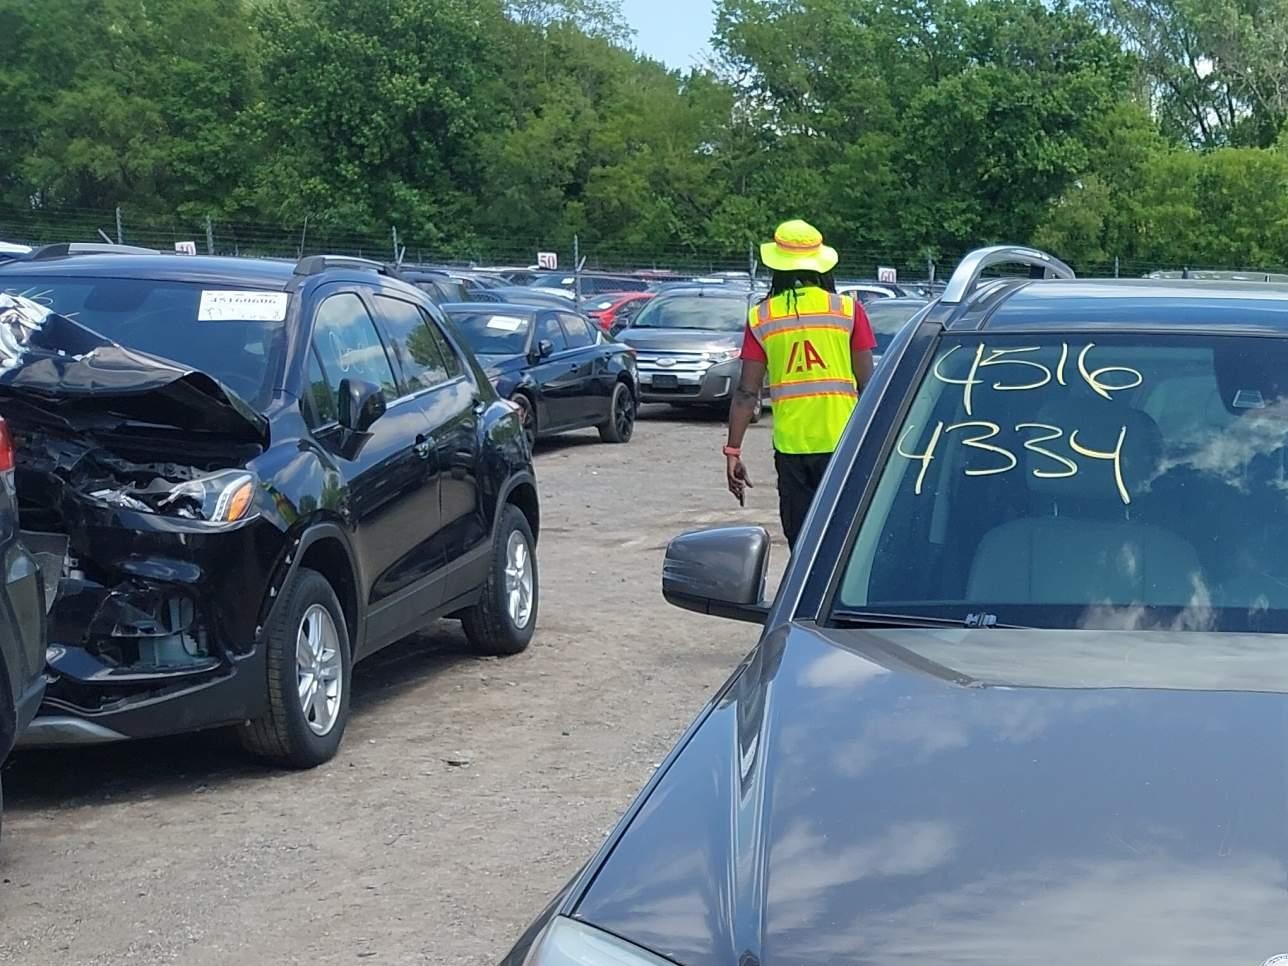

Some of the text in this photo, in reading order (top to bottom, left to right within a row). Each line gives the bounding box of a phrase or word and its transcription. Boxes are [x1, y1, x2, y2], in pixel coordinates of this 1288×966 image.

[540, 254, 555, 268] 50
[934, 343, 1143, 416] 4516
[896, 421, 1131, 504] 4334
